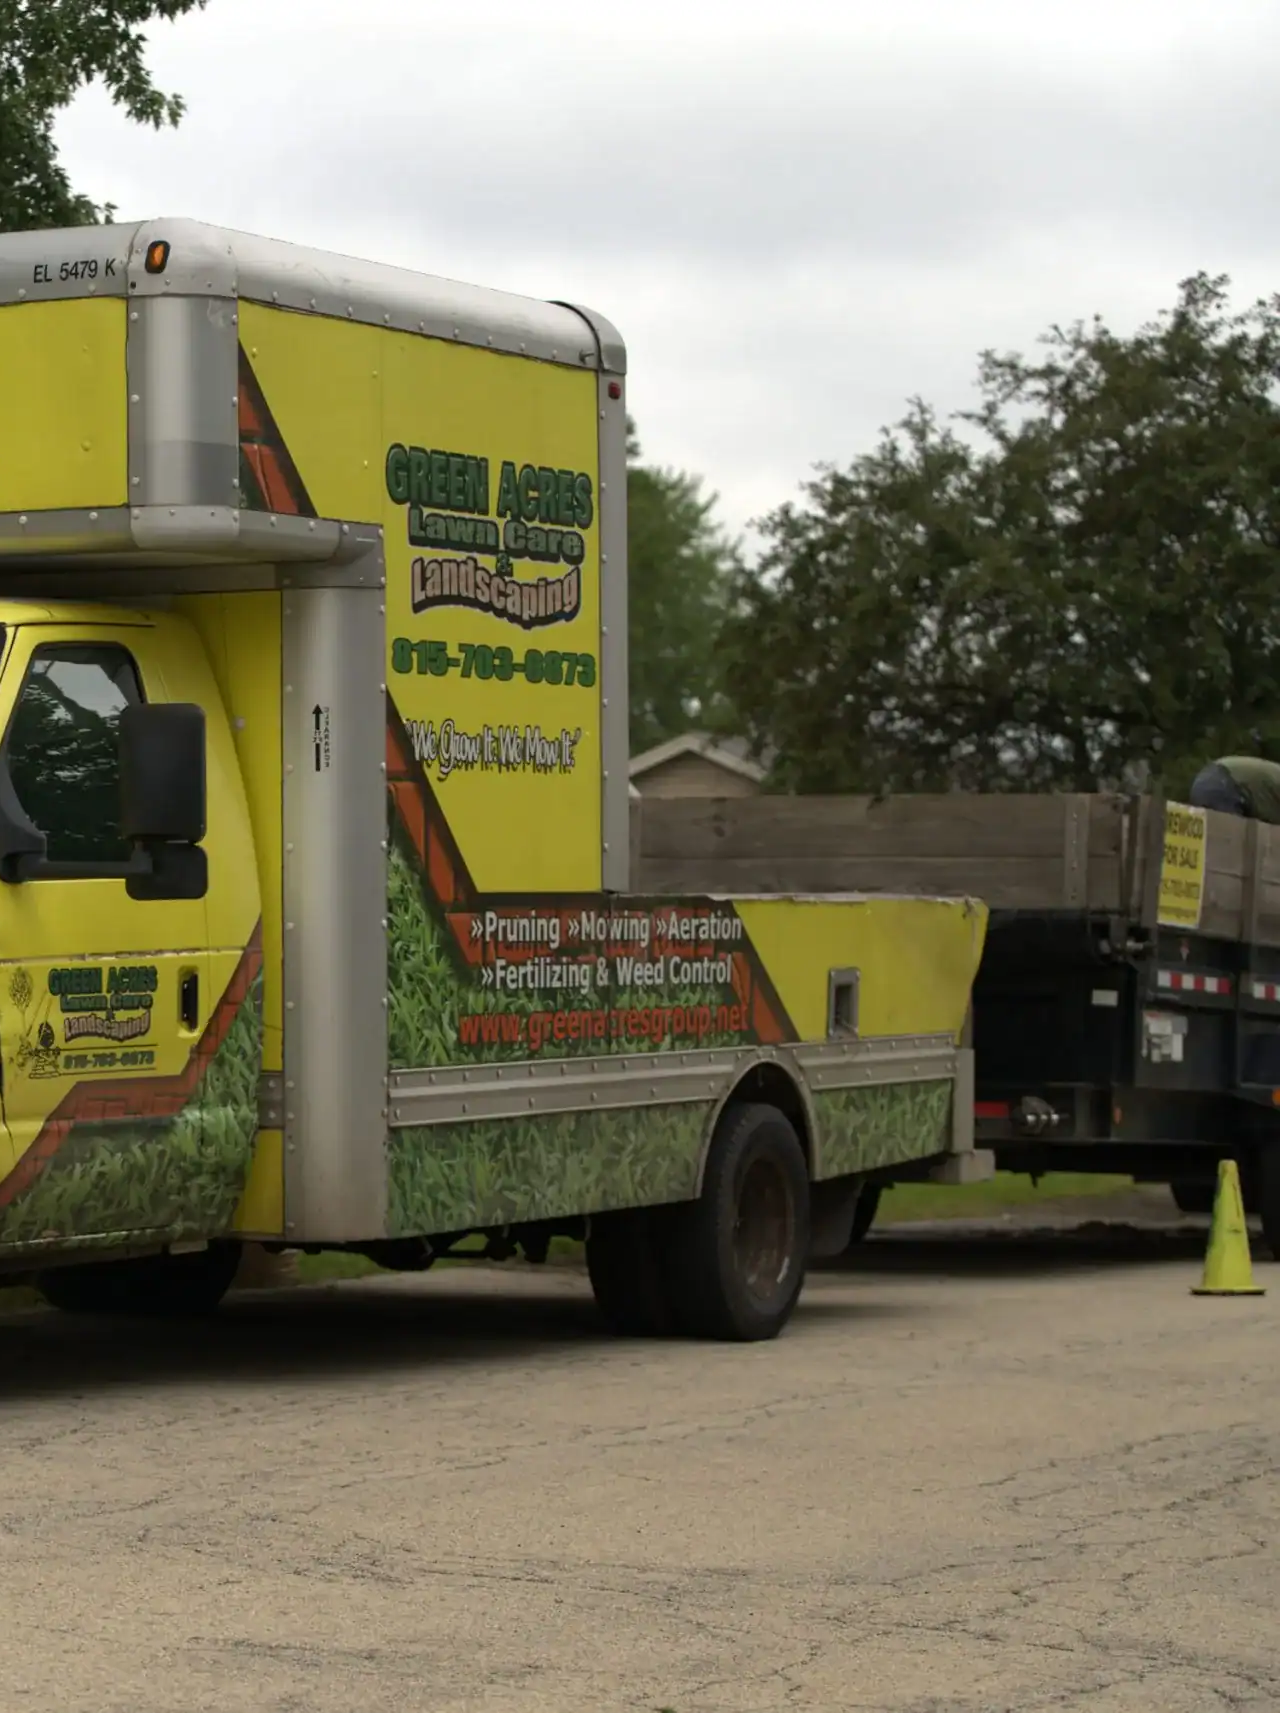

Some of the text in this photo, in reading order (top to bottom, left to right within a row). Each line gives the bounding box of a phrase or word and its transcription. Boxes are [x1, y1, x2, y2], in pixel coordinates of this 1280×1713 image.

[33, 258, 116, 283] EL 5479 K
[386, 443, 593, 529] GREEN ACRES
[408, 505, 585, 565] Lawn Care
[496, 551, 513, 577] &
[411, 557, 581, 630] Landscaping
[392, 637, 596, 687] 815-703-0873
[437, 718, 480, 780] Grow
[498, 724, 523, 766] We
[525, 725, 560, 768] Mow
[48, 965, 158, 996] GREEN ACRES
[596, 957, 609, 986] &
[616, 956, 664, 987] Weed
[670, 953, 732, 984] Control
[64, 1008, 151, 1042] Landscaping
